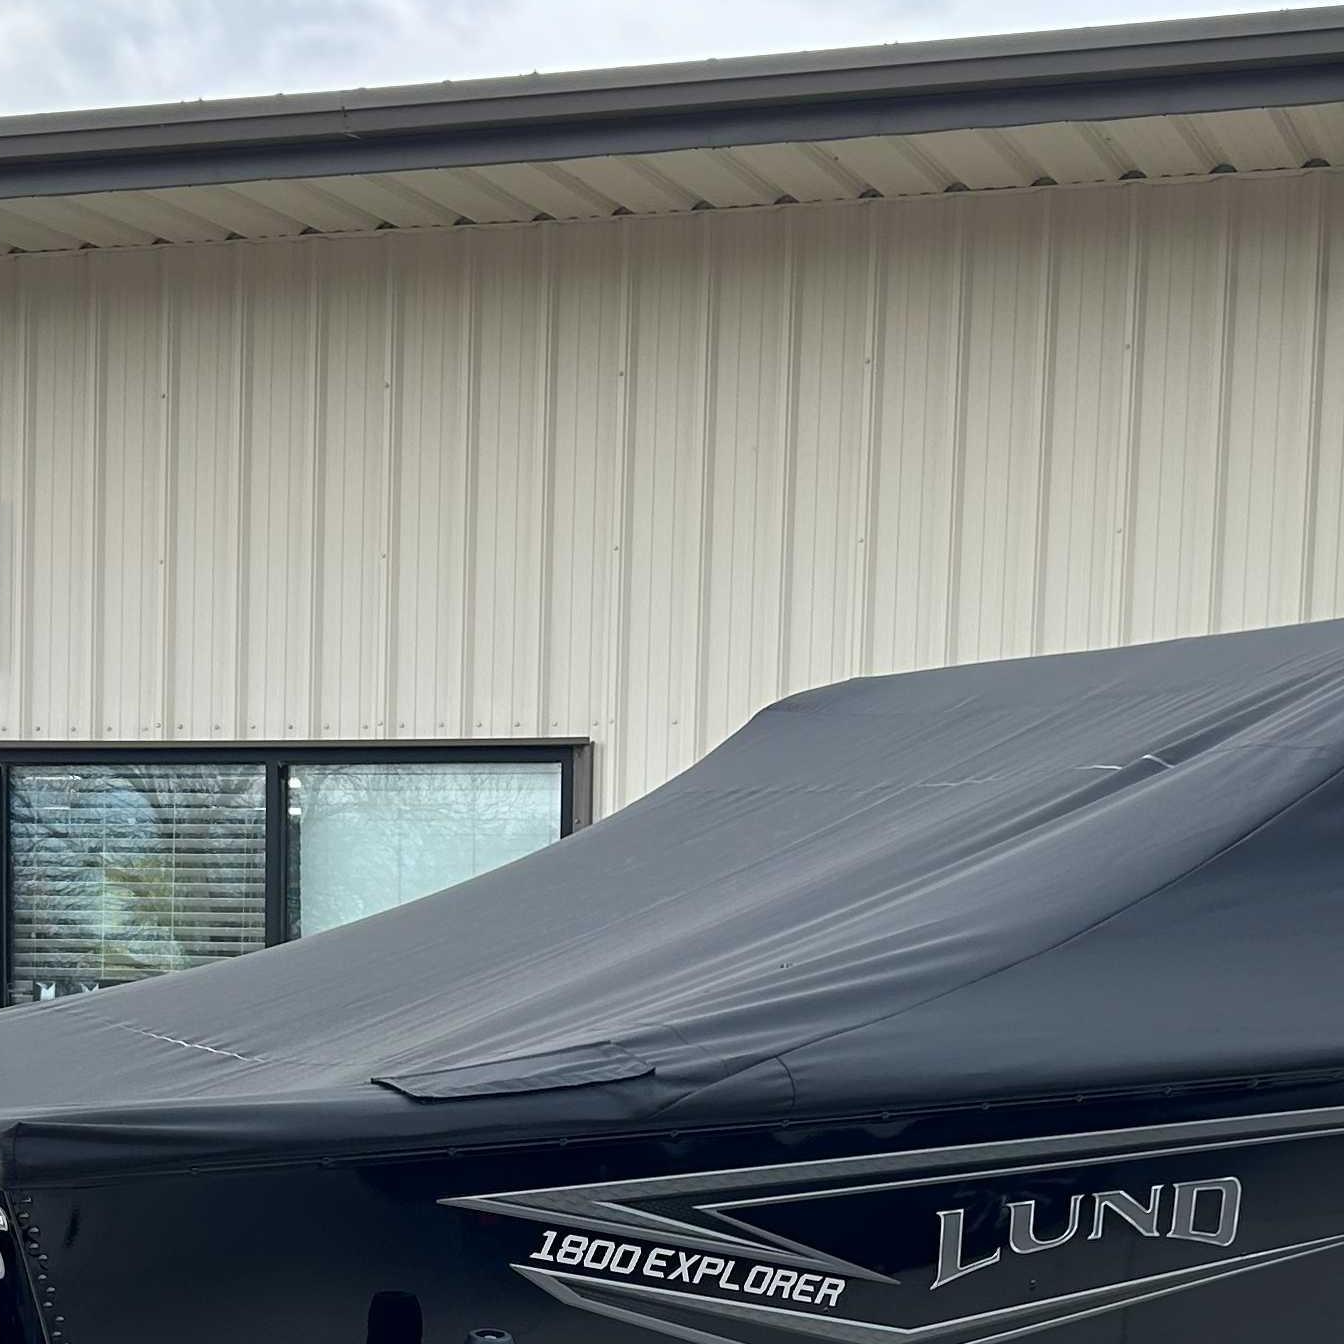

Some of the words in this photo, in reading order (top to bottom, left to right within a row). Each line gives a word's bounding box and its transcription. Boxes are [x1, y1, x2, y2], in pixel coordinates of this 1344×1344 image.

[529, 1230, 642, 1274] 1800
[643, 1247, 846, 1307] EXPLORER
[929, 1176, 1242, 1291] LUND
